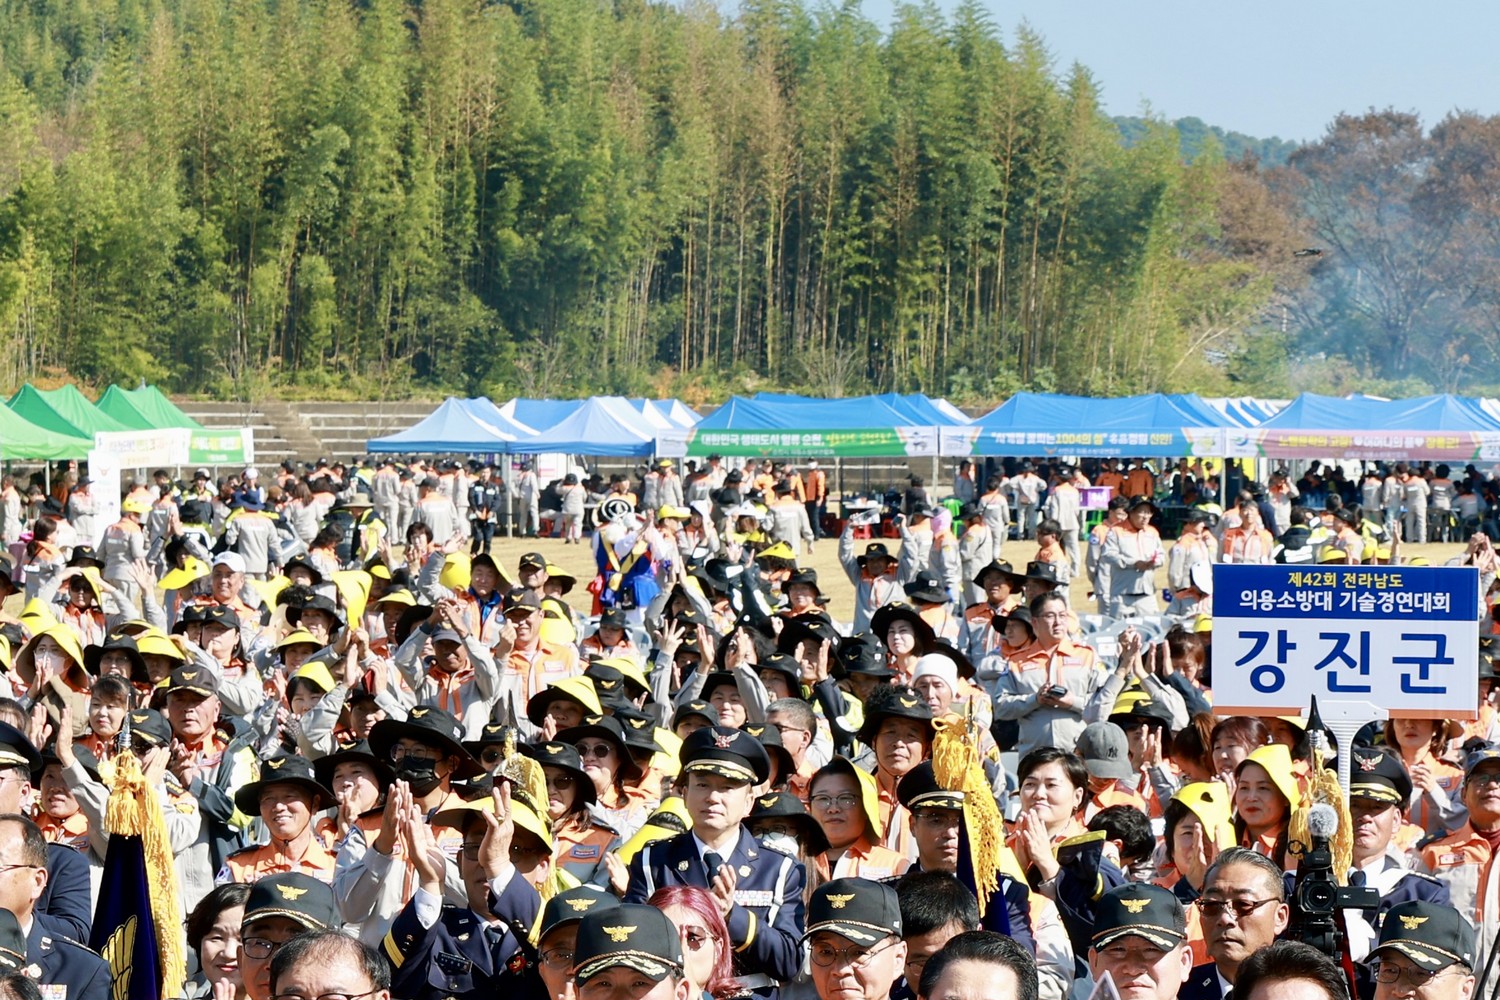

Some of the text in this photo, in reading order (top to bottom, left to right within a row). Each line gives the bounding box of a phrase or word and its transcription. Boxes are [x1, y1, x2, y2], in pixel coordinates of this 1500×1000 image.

[1287, 572, 1404, 588] 제42회 전라남도
[1239, 589, 1451, 613] 의용소방대 기술경연대회
[1235, 629, 1454, 694] 강진군
